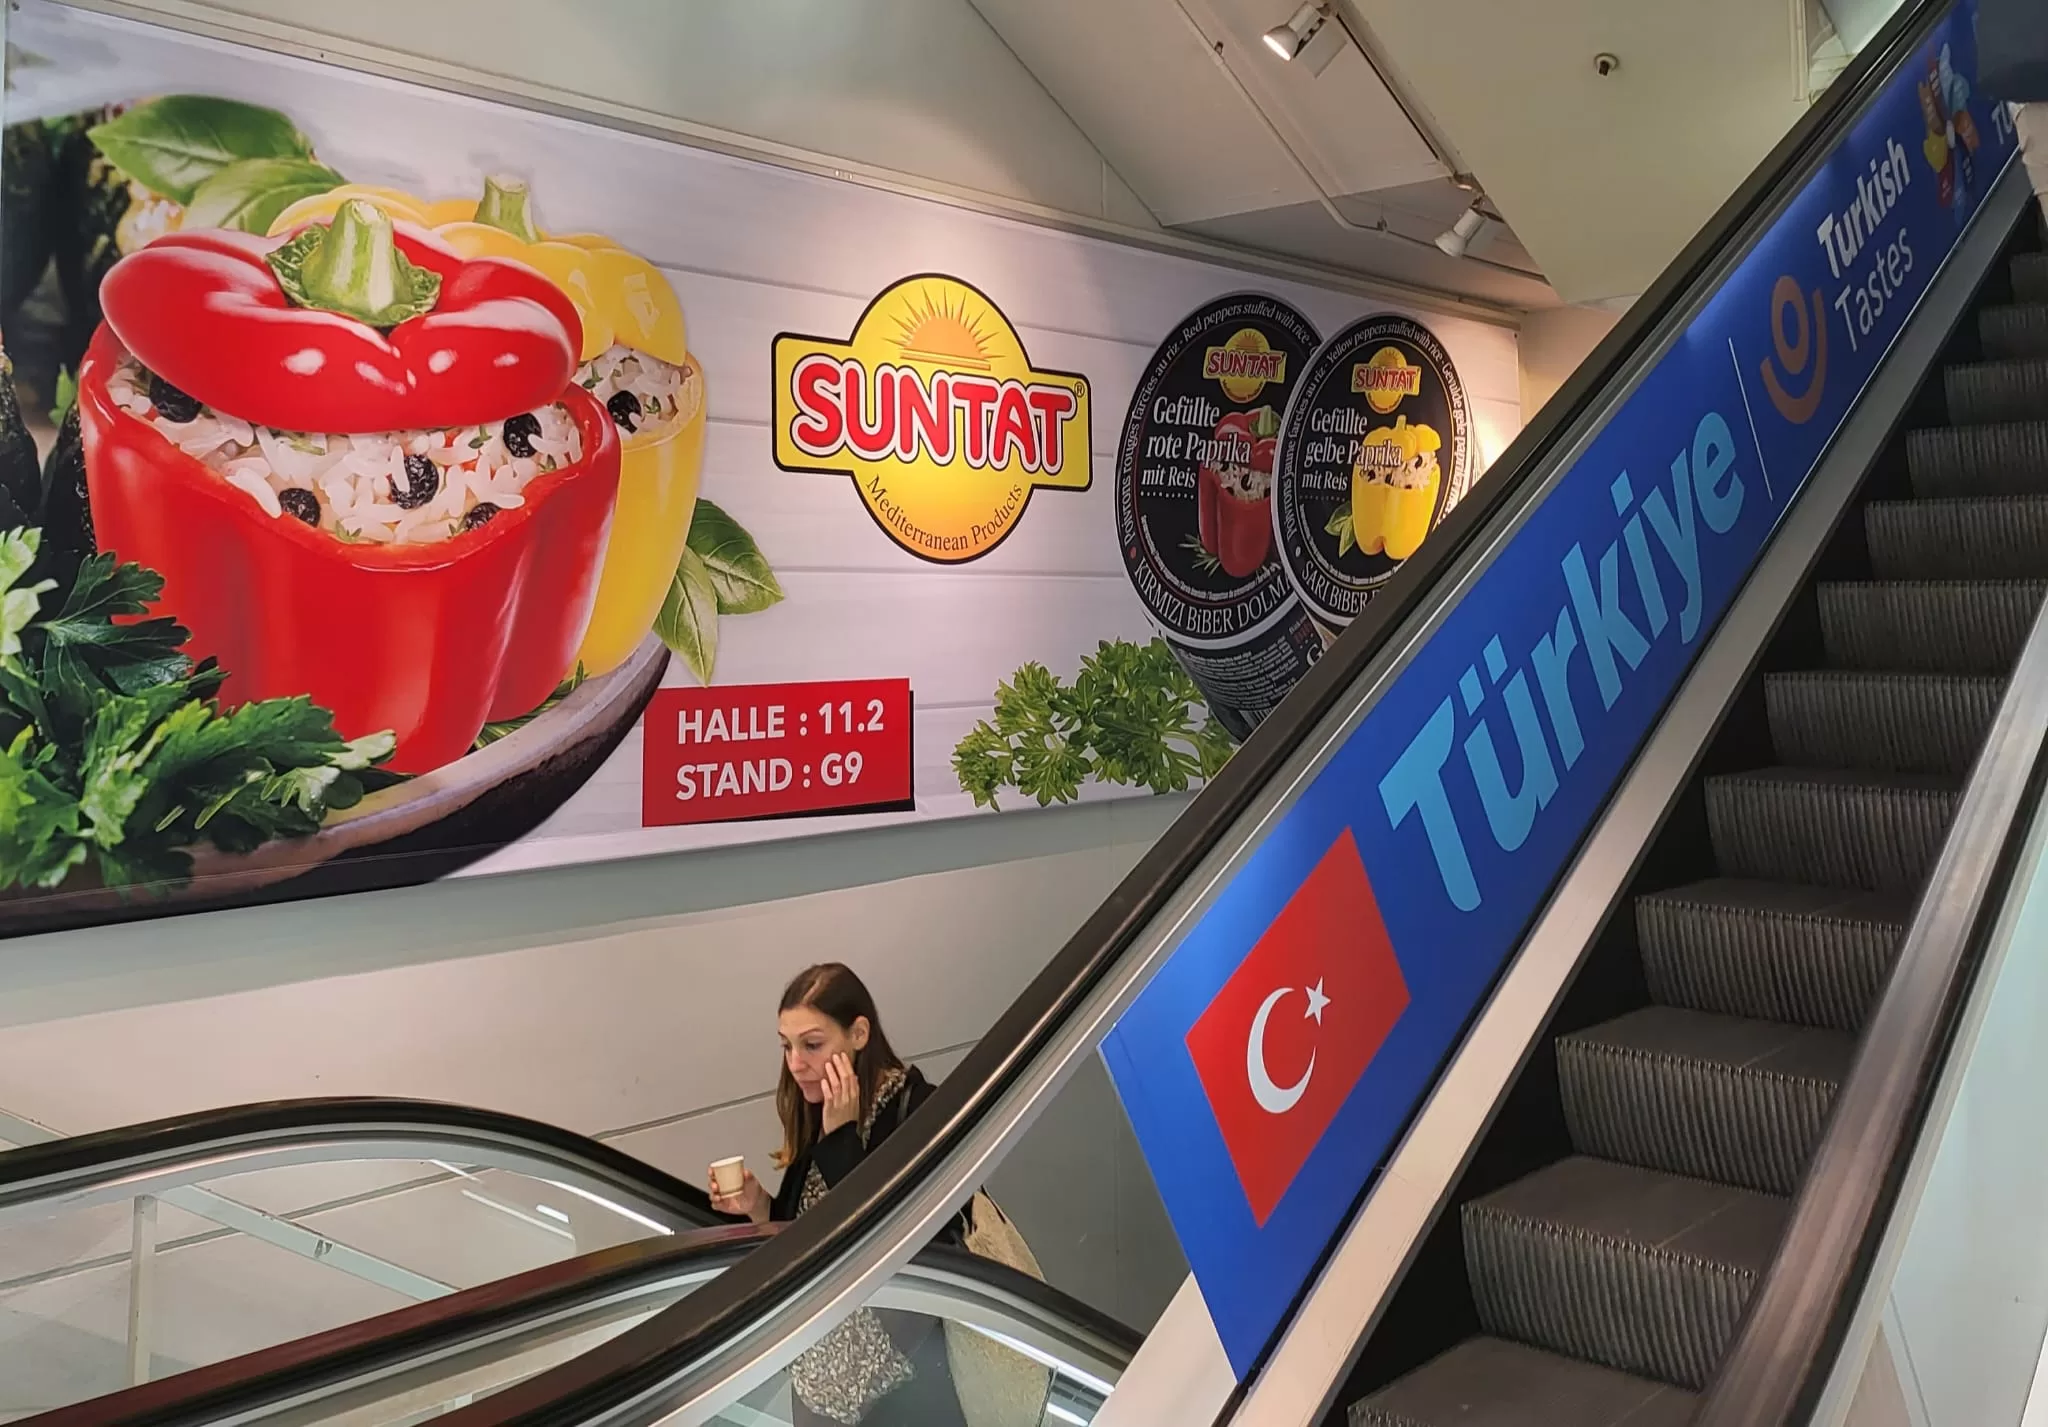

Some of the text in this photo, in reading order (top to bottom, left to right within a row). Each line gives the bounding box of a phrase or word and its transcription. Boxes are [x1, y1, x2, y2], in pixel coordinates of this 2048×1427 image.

[1817, 136, 1910, 279] Turkish
[1834, 225, 1913, 353] Tastes
[1327, 336, 1354, 364] Yellow
[1354, 323, 1388, 345] peppers
[1387, 321, 1415, 339] stuffed
[1414, 329, 1432, 350] with
[1206, 350, 1282, 380] SUNTAT
[1354, 366, 1417, 393] SUNTAT
[1122, 422, 1140, 475] rouges
[1133, 374, 1159, 420] farcies
[1154, 357, 1168, 377] au
[1182, 318, 1203, 342] Red
[1203, 303, 1242, 330] peppers
[1243, 300, 1275, 319] stuffed
[1275, 310, 1294, 330] with
[1292, 319, 1309, 343] rice
[1153, 395, 1220, 428] Gefüllte
[1311, 406, 1368, 436] Gefüllte
[1146, 431, 1251, 469] rote Paprika
[1303, 437, 1403, 471] gelbe Paprika
[1141, 465, 1196, 489] mit Reis
[1301, 470, 1348, 492] mit Reis
[865, 473, 1023, 552] Mediterranean Products
[1301, 560, 1329, 605] SARI
[1378, 411, 1746, 913] Türkiye
[677, 698, 885, 745] HALLE : 11.2
[675, 750, 864, 801] STAND : G9
